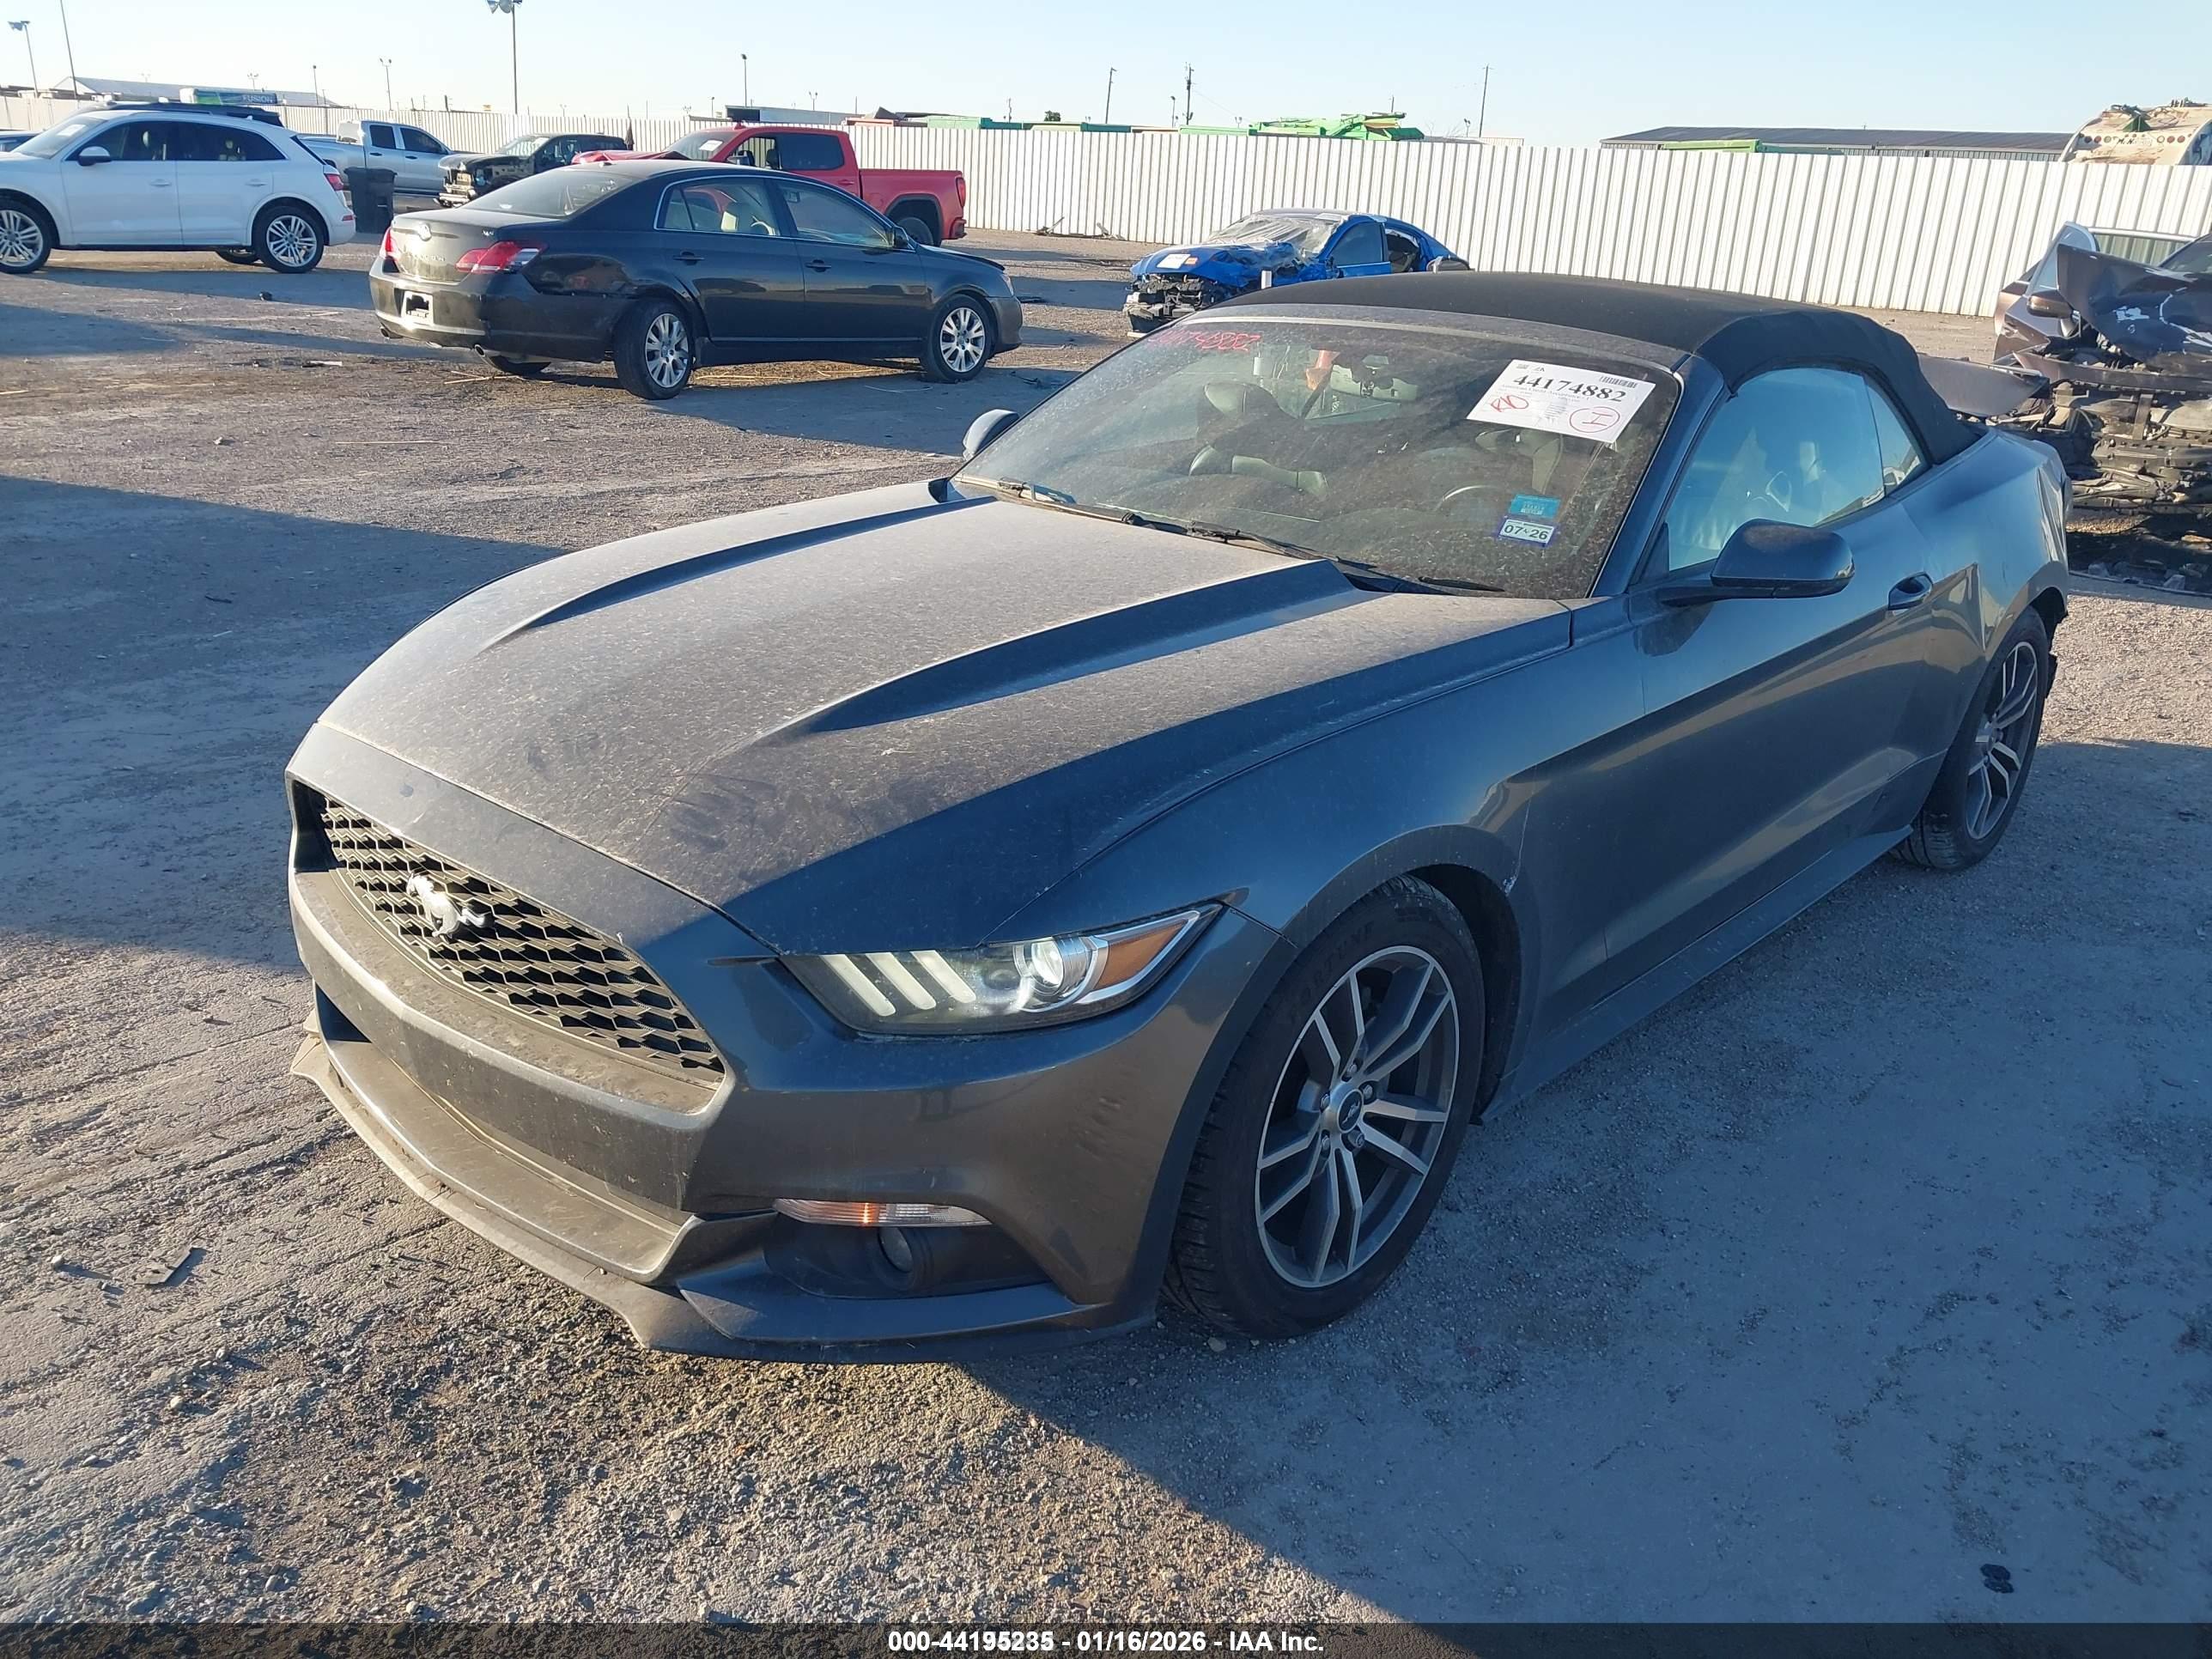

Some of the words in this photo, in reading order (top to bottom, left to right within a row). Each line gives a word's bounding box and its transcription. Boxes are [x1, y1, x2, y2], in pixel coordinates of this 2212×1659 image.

[1514, 374, 1626, 403] 44174882
[1504, 525, 1523, 535] 07
[1528, 529, 1549, 540] 26
